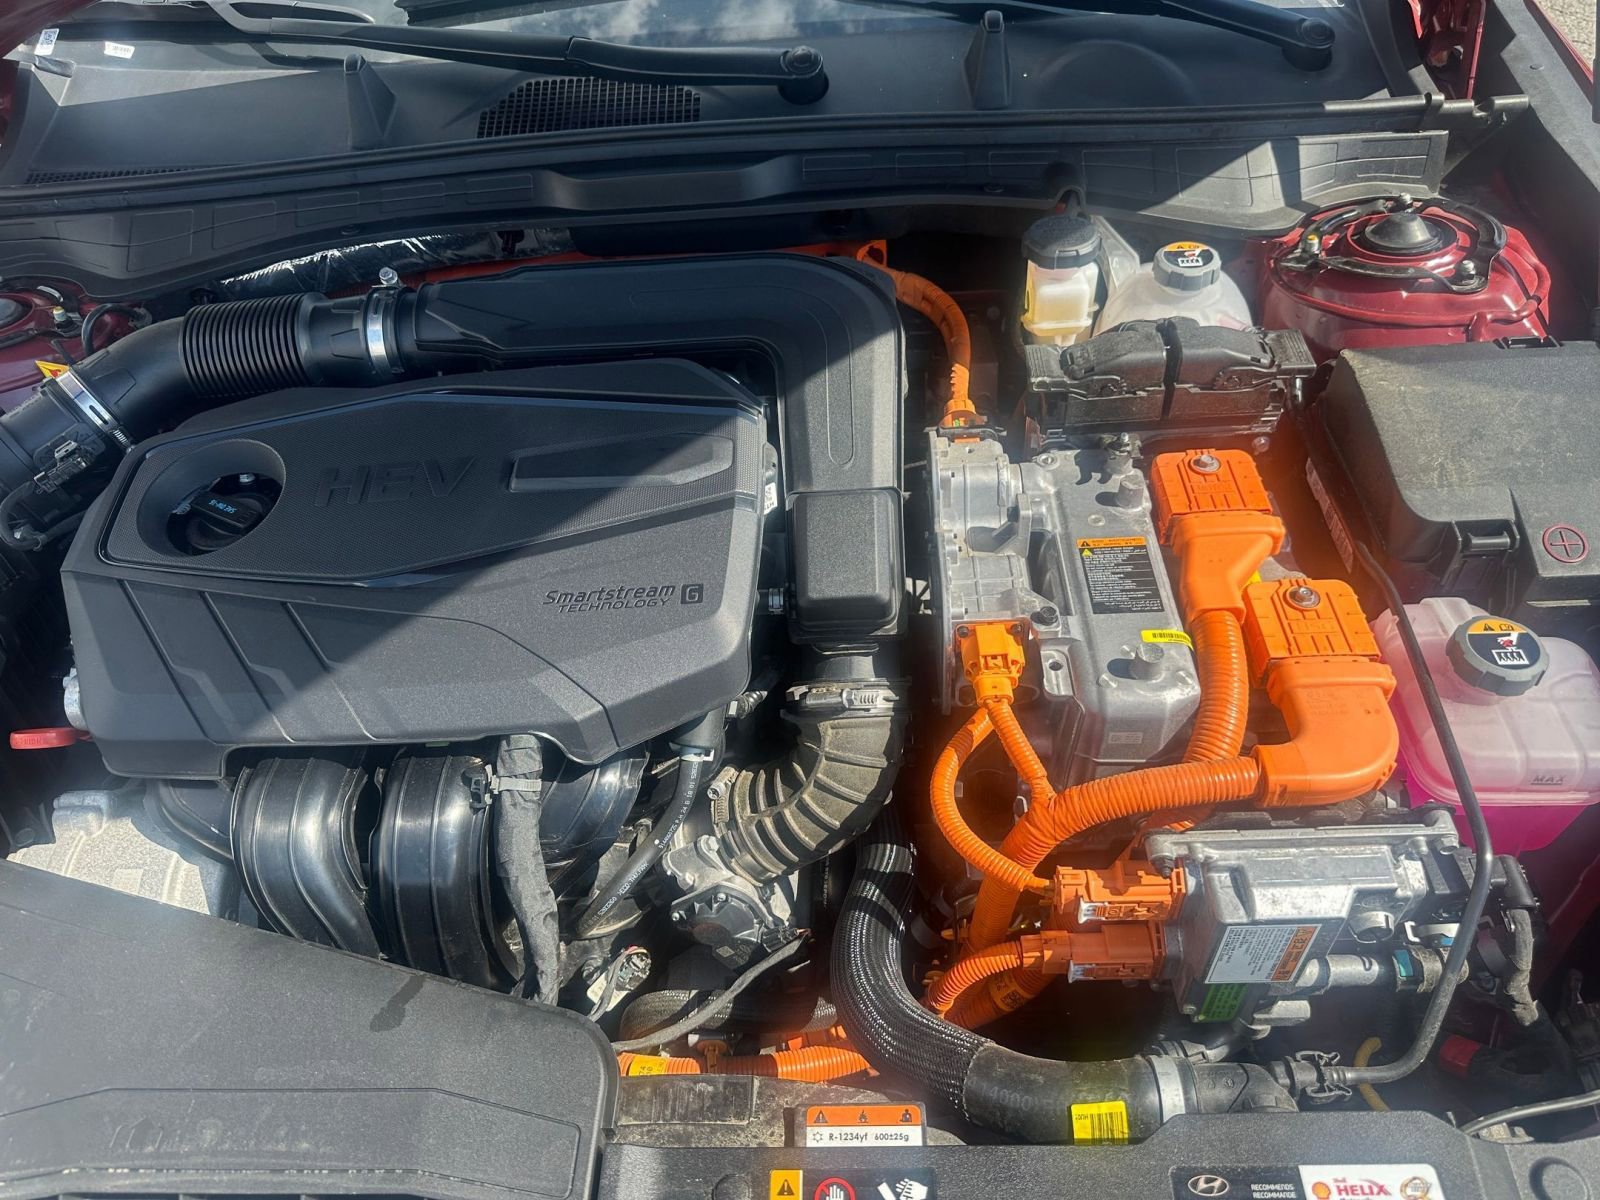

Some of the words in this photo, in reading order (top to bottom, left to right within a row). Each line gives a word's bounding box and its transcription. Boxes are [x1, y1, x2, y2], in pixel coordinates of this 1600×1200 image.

[313, 456, 477, 507] HEV
[543, 584, 676, 605] Smartstream
[558, 598, 671, 613] TECHNOLOGY
[1532, 775, 1566, 784] MAX
[828, 1132, 868, 1143] R-1234yf
[874, 1132, 910, 1142] 600±25g
[1250, 1183, 1295, 1191] RECOMMENDS
[1336, 1184, 1390, 1196] HELIX
